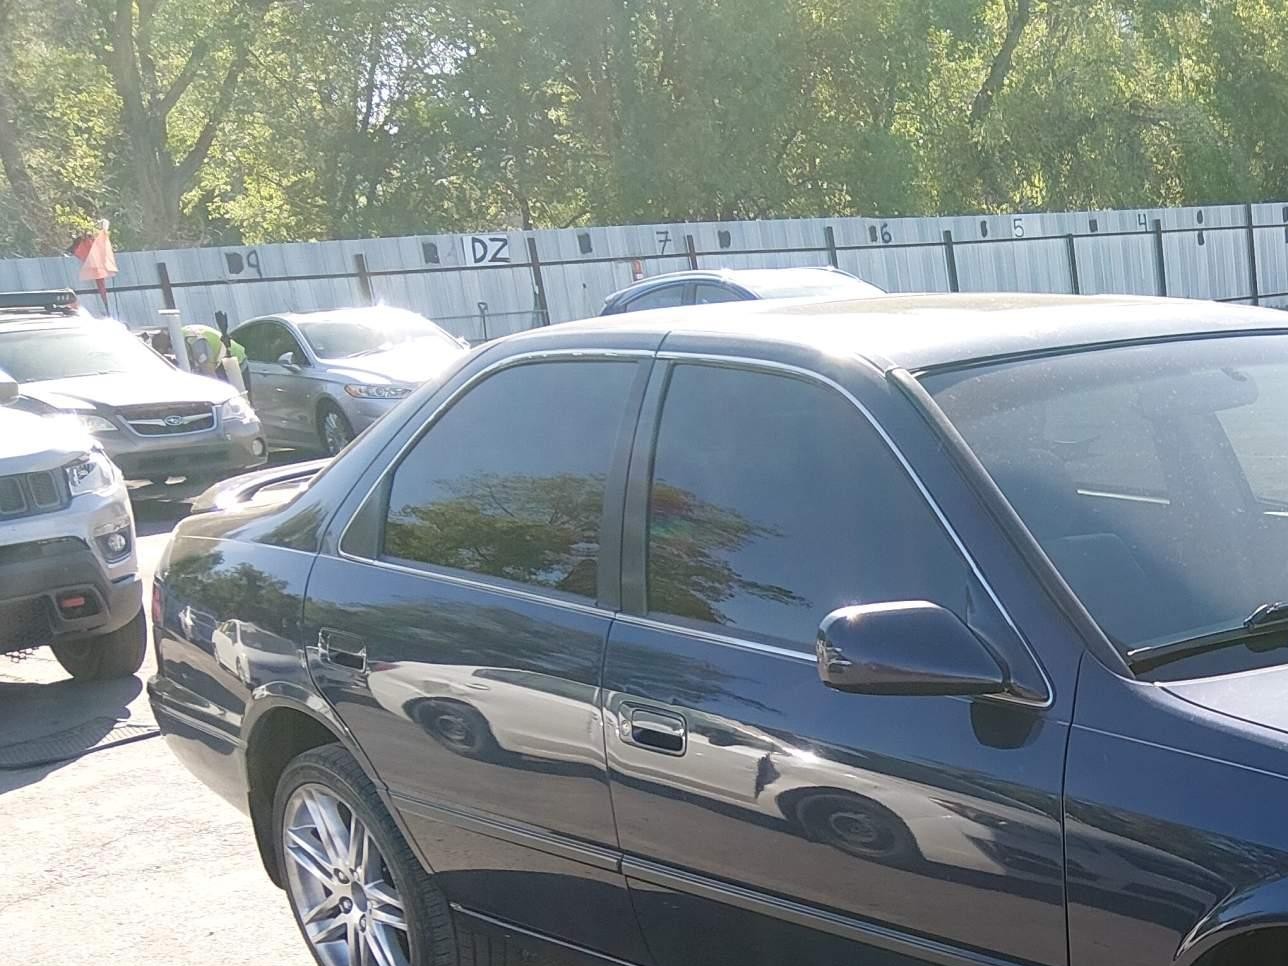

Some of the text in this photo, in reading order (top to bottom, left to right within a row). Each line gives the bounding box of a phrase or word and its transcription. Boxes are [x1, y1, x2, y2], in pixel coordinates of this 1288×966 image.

[881, 222, 892, 243] 6
[1013, 218, 1024, 237] 5
[1138, 213, 1147, 232] 4
[471, 236, 510, 263] DZ
[656, 230, 671, 254] 7
